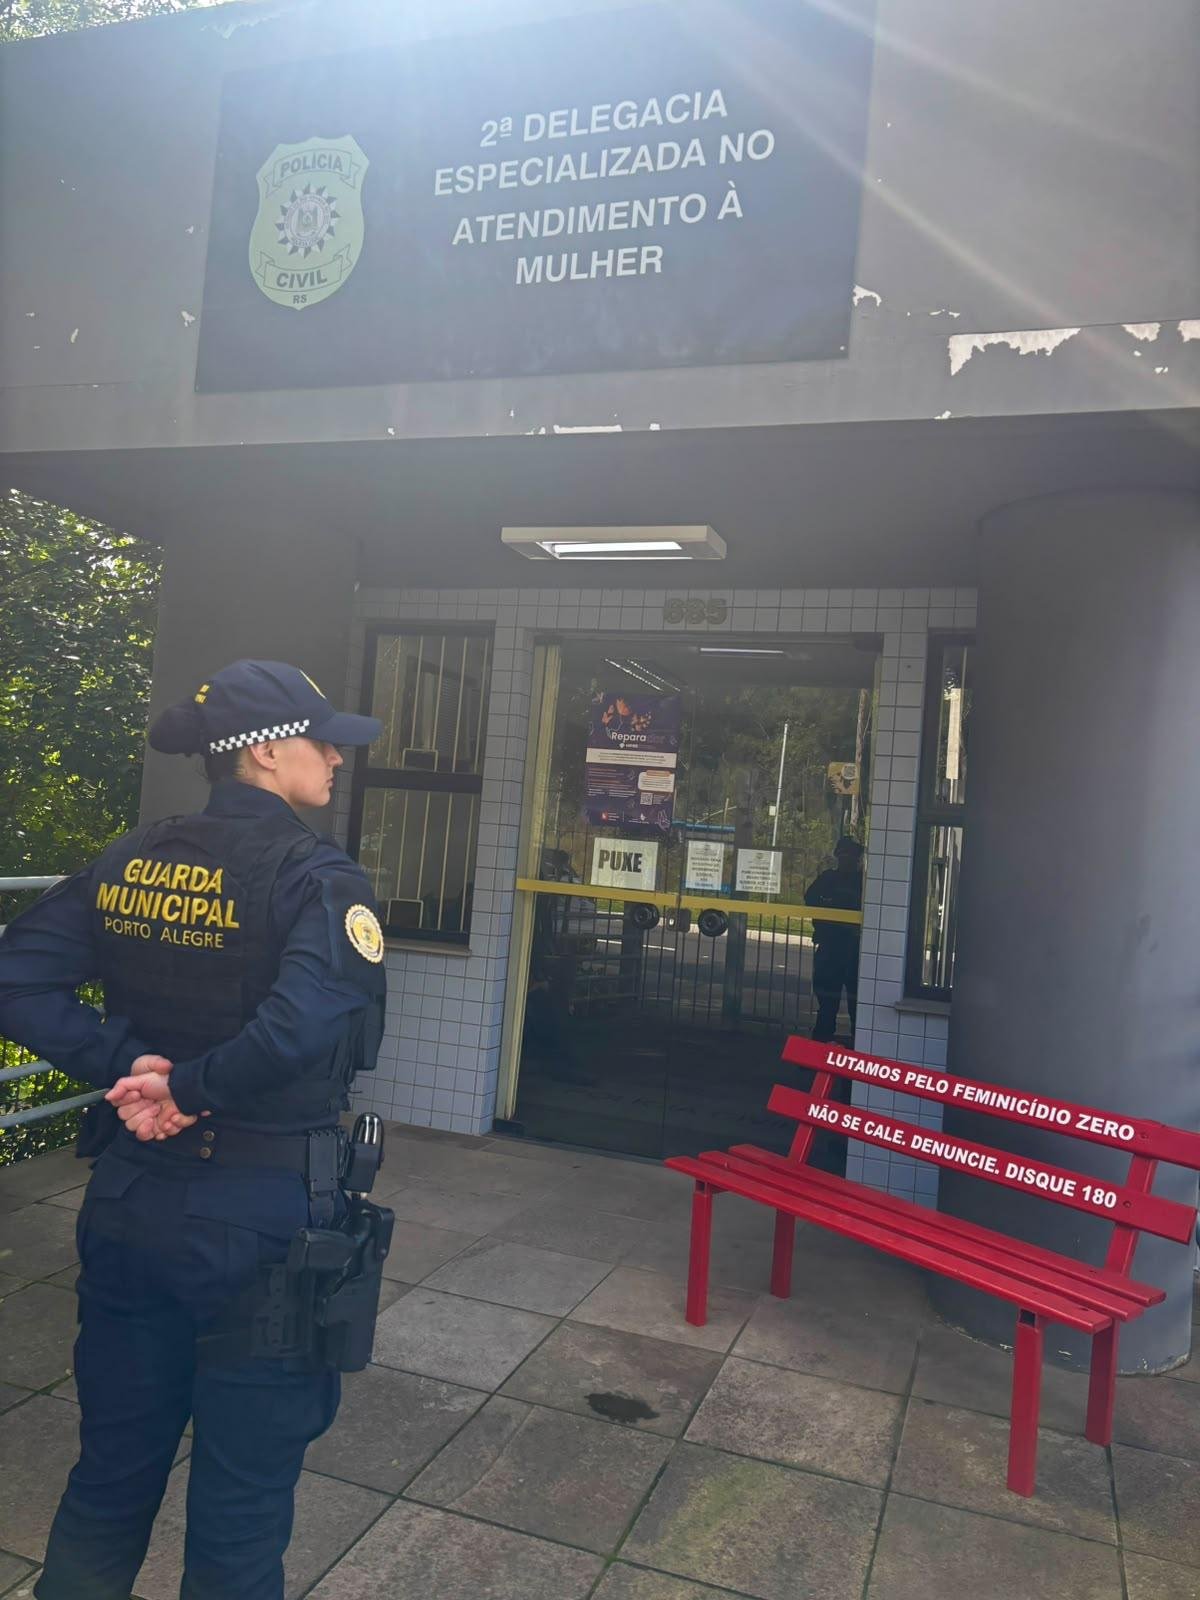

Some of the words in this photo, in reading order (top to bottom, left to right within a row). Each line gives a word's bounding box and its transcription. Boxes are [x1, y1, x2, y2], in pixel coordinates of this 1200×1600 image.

[480, 117, 512, 147] 2ª
[523, 89, 728, 142] DELEGACIA
[434, 138, 706, 196] ESPECIALIZADA
[719, 129, 775, 164] NO
[452, 193, 706, 245] ATENDIMENTO
[717, 181, 743, 220] À
[276, 270, 328, 288] CIVIL
[516, 245, 663, 284] MULHER
[293, 294, 307, 304] RS
[124, 858, 223, 894] GUARDA
[599, 850, 643, 873] PUXE
[96, 882, 240, 928] MUNICIPAL
[104, 916, 151, 938] PORTO
[160, 926, 224, 948] ALEGRE
[826, 1051, 901, 1082] LUTAMOS
[904, 1072, 949, 1094] PELO
[952, 1083, 1071, 1126] FEMINICÍDIO
[1075, 1113, 1135, 1141] ZERO
[807, 1103, 839, 1123] NÃO
[841, 1114, 860, 1131] SE
[863, 1120, 906, 1146] CALE.
[910, 1134, 1000, 1175] DENUNCIE.
[1004, 1162, 1076, 1197] DISQUE
[1081, 1185, 1117, 1209] 180
